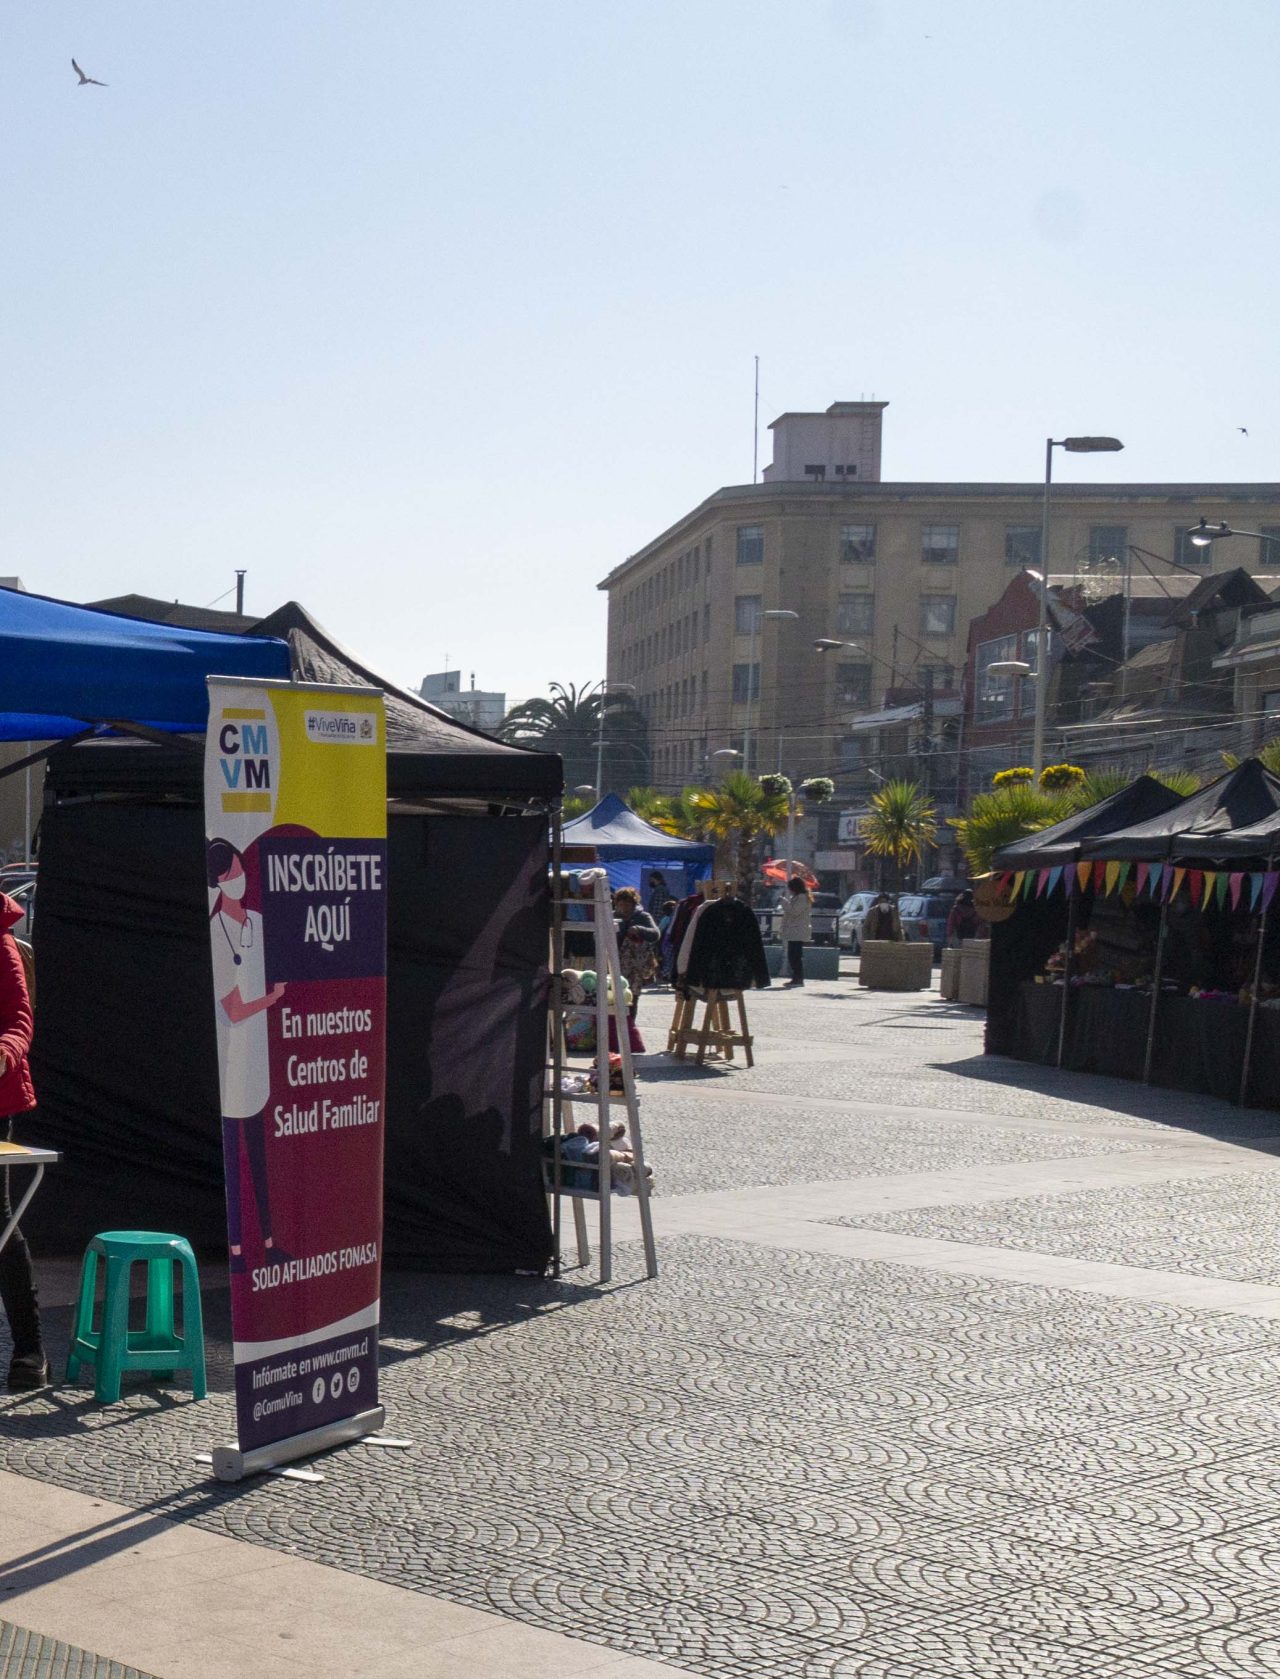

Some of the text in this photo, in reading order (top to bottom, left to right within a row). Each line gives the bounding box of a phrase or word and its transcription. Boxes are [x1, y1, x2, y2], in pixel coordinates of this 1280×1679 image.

[220, 724, 268, 755] CM
[308, 716, 356, 733] #ViveViña
[220, 759, 270, 788] VM
[268, 847, 381, 892] INSCRÍBETE
[304, 897, 351, 951] AQUÍ
[282, 1006, 372, 1038] En nuestros
[287, 1049, 368, 1087] Centros de
[274, 1095, 380, 1137] Salud Familiar
[252, 1242, 377, 1292] SOLO AFILIADOS FONASA
[252, 1337, 369, 1389] Infórmate en www.cmvm.cl
